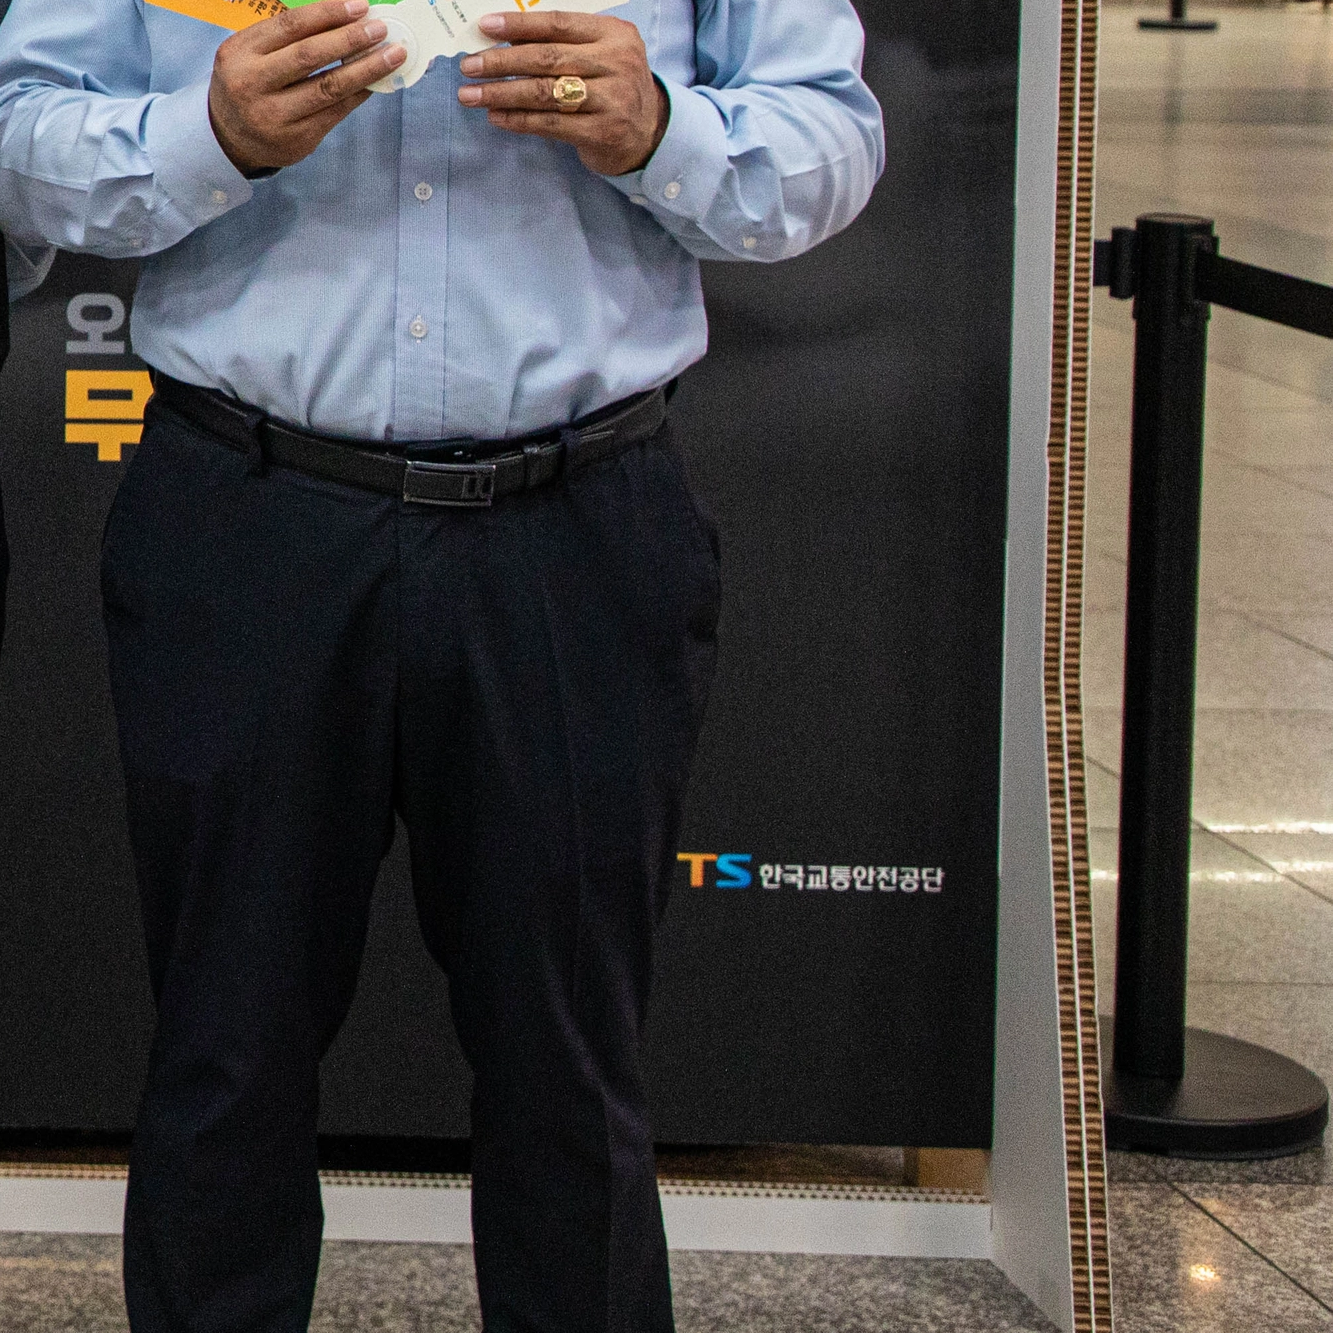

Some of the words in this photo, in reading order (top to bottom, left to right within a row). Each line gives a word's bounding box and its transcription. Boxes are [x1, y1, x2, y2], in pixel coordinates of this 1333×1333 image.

[255, 0, 268, 16] 7명
[677, 852, 752, 888] TS
[759, 864, 945, 893] 한국교통안전공단
